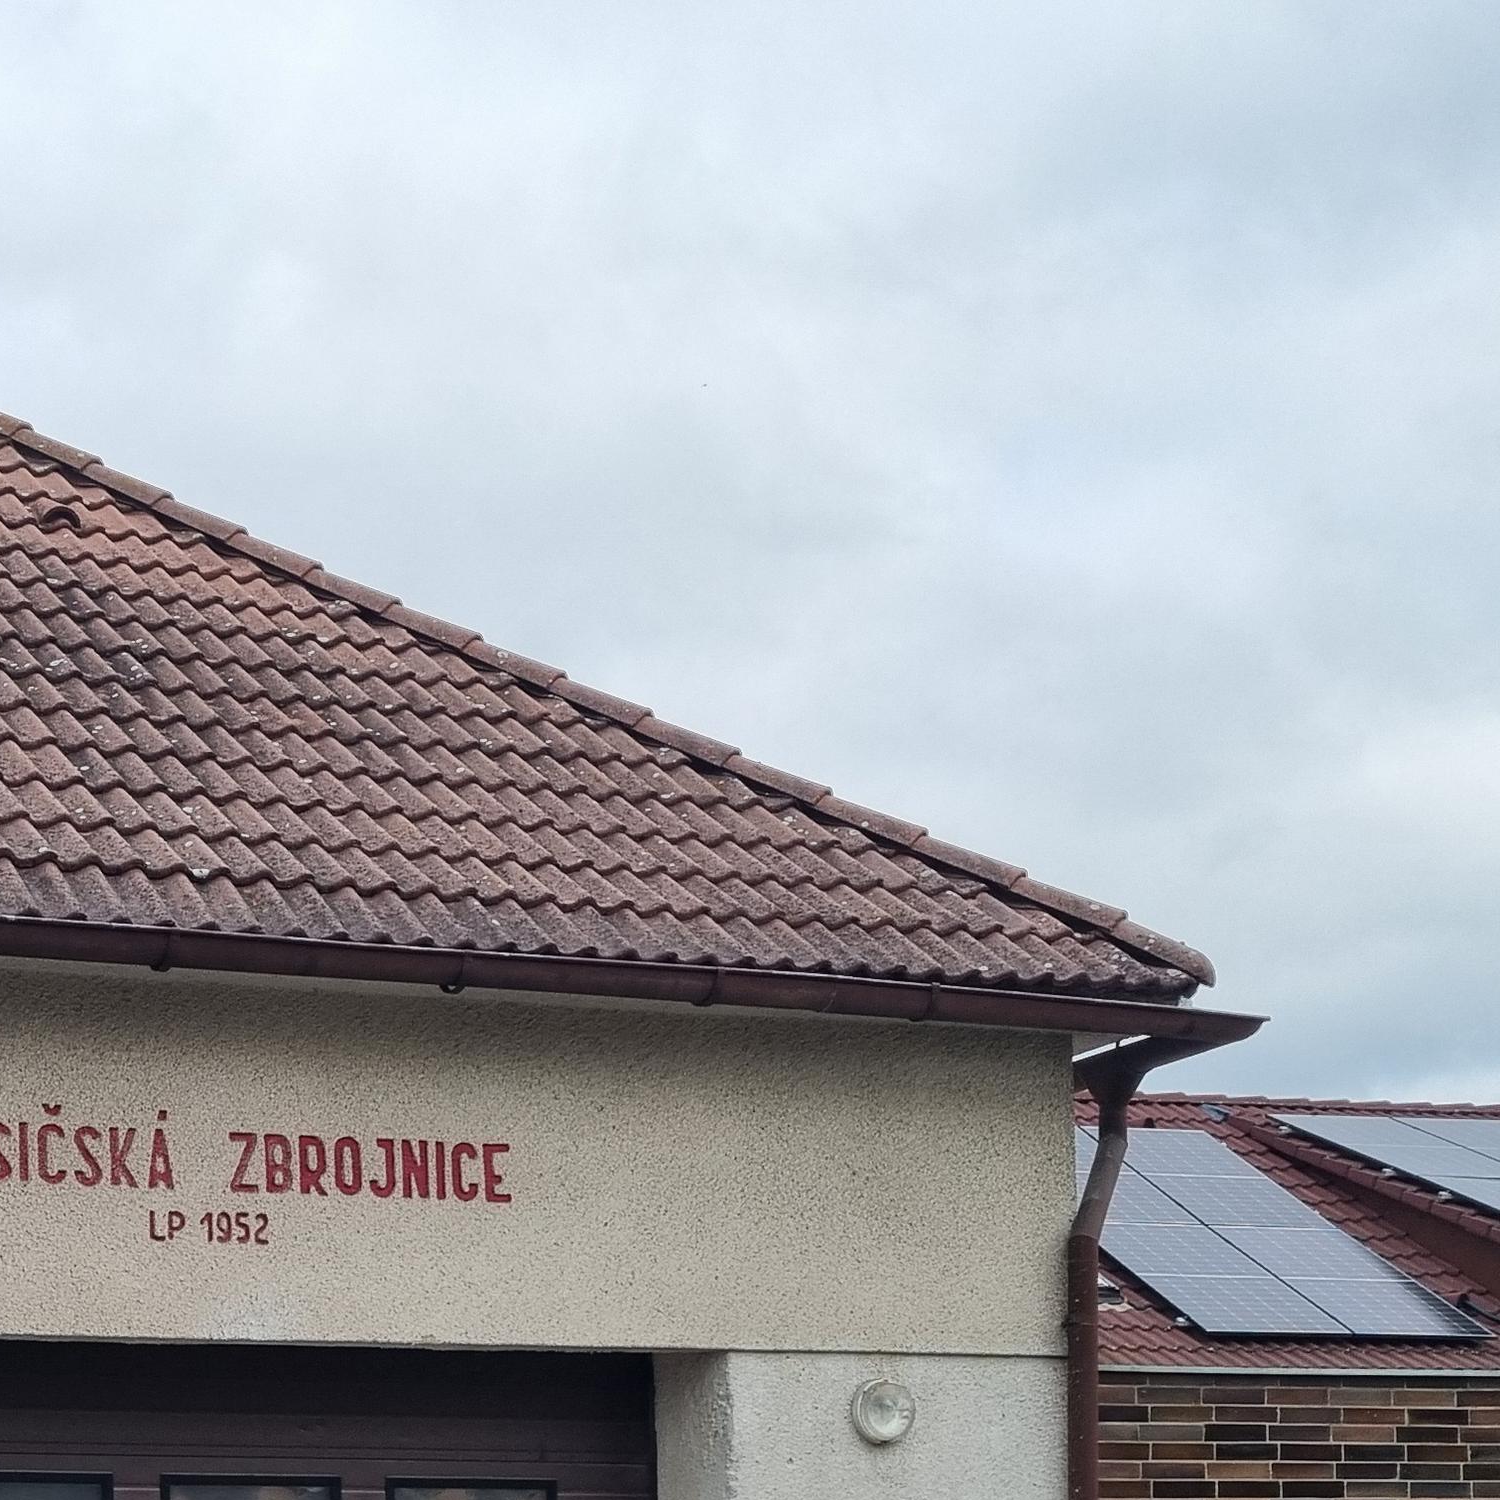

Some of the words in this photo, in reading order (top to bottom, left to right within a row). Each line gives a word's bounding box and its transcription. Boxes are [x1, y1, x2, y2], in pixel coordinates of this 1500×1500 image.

[228, 1131, 512, 1203] ZBROJNICE
[149, 1210, 186, 1241] LP
[200, 1211, 269, 1245] 1952
